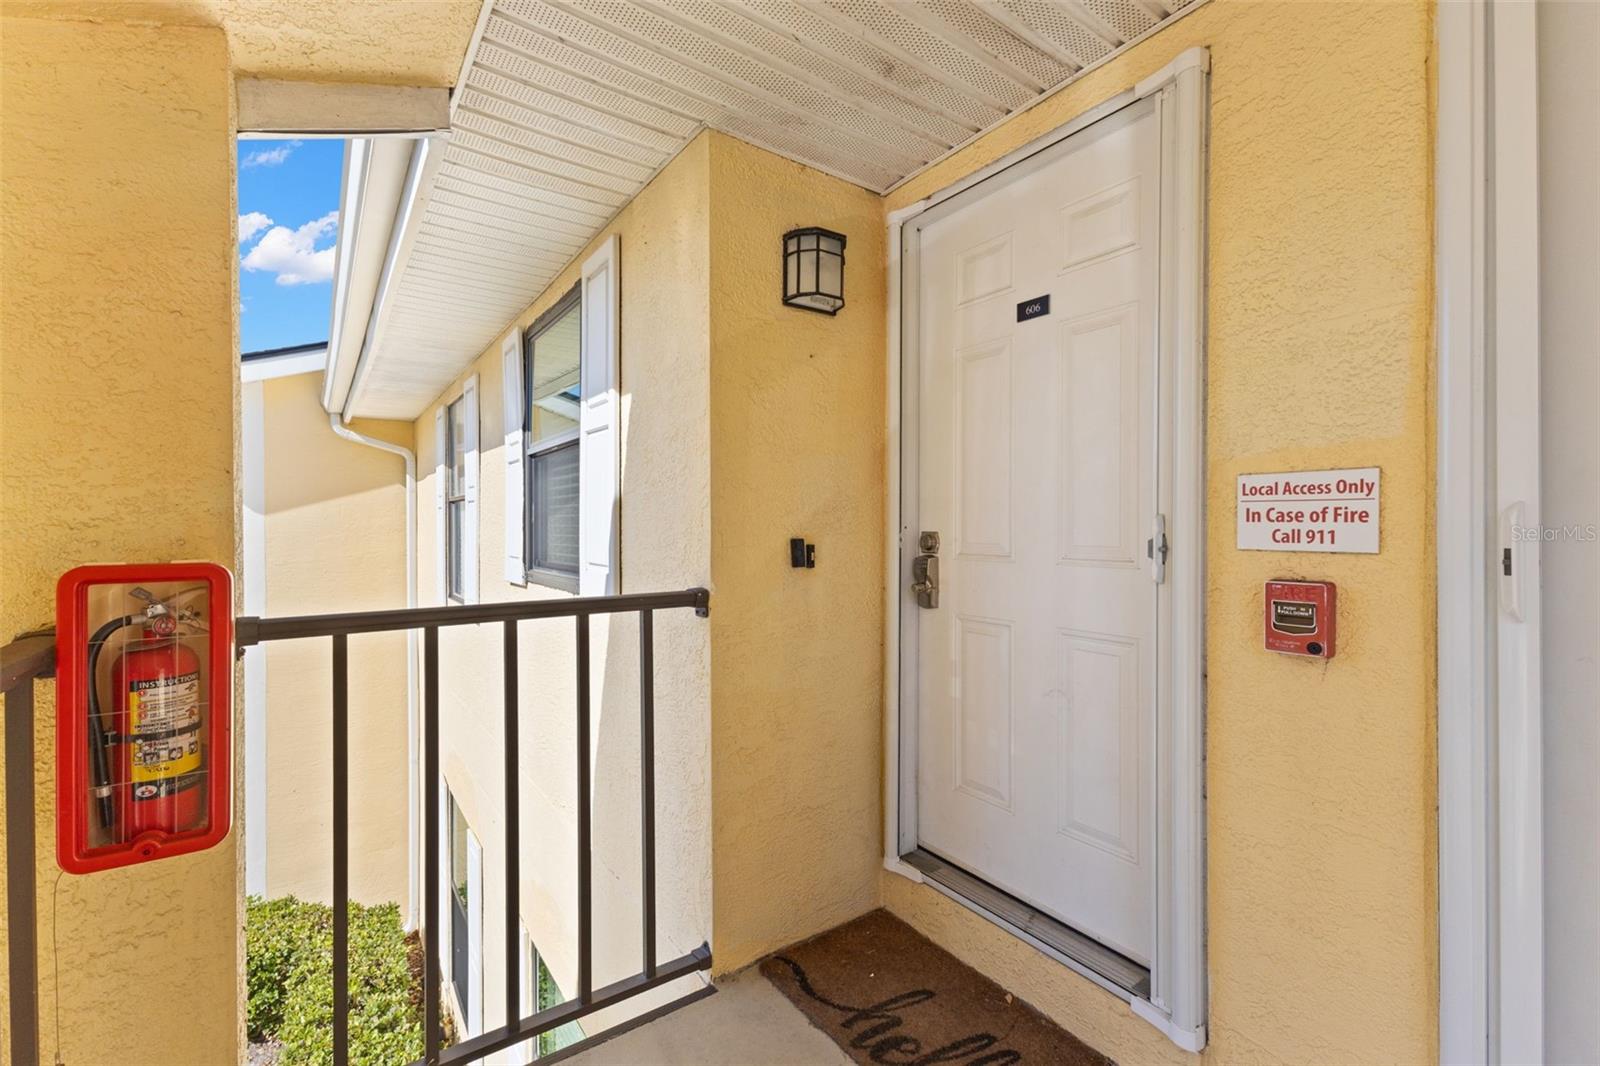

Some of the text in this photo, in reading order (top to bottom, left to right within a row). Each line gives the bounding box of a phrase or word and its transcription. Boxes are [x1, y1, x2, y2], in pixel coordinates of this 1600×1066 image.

[1026, 303, 1041, 315] 606
[1242, 478, 1375, 497] Local Access Only
[1245, 506, 1370, 523] In Case of Fire
[1271, 528, 1335, 545] Call 911
[139, 674, 198, 688] INSTRUCTION
